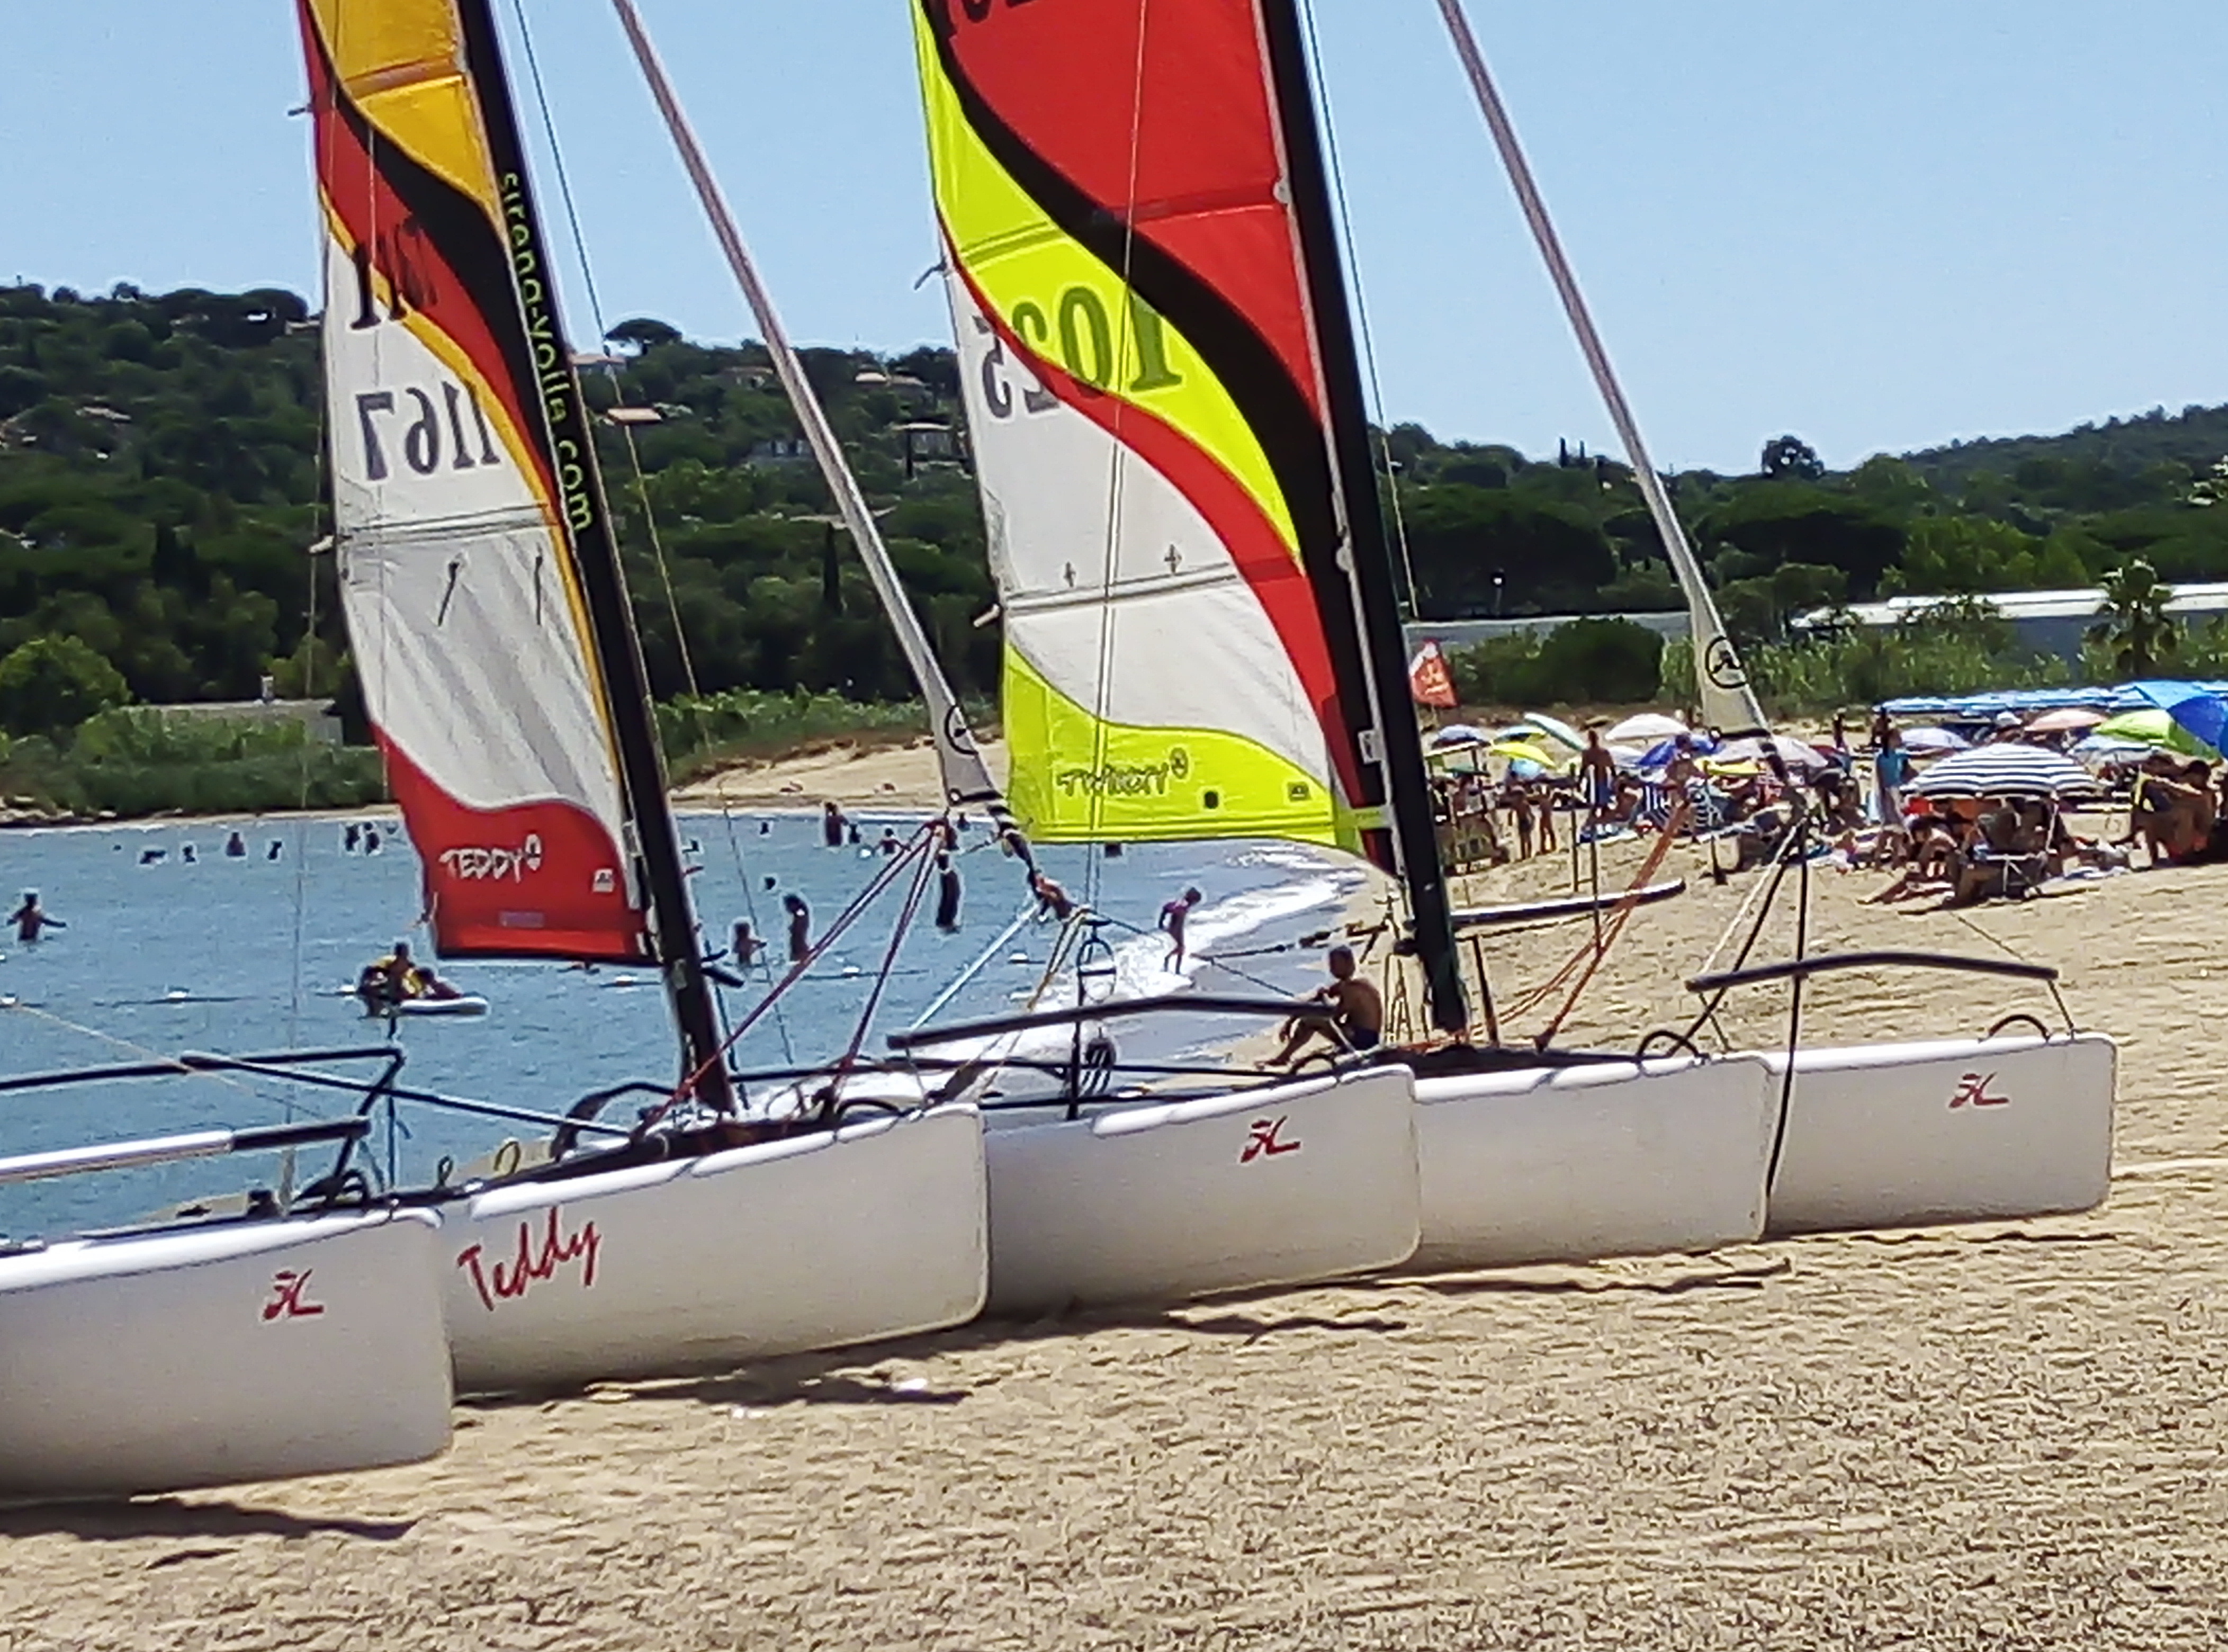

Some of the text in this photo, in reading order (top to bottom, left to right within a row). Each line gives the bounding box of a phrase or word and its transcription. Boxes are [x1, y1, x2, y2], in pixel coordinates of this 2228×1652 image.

[504, 173, 594, 531] sirena-voilecom
[438, 848, 522, 884] TEDDY
[457, 1205, 601, 1312] Teddy
